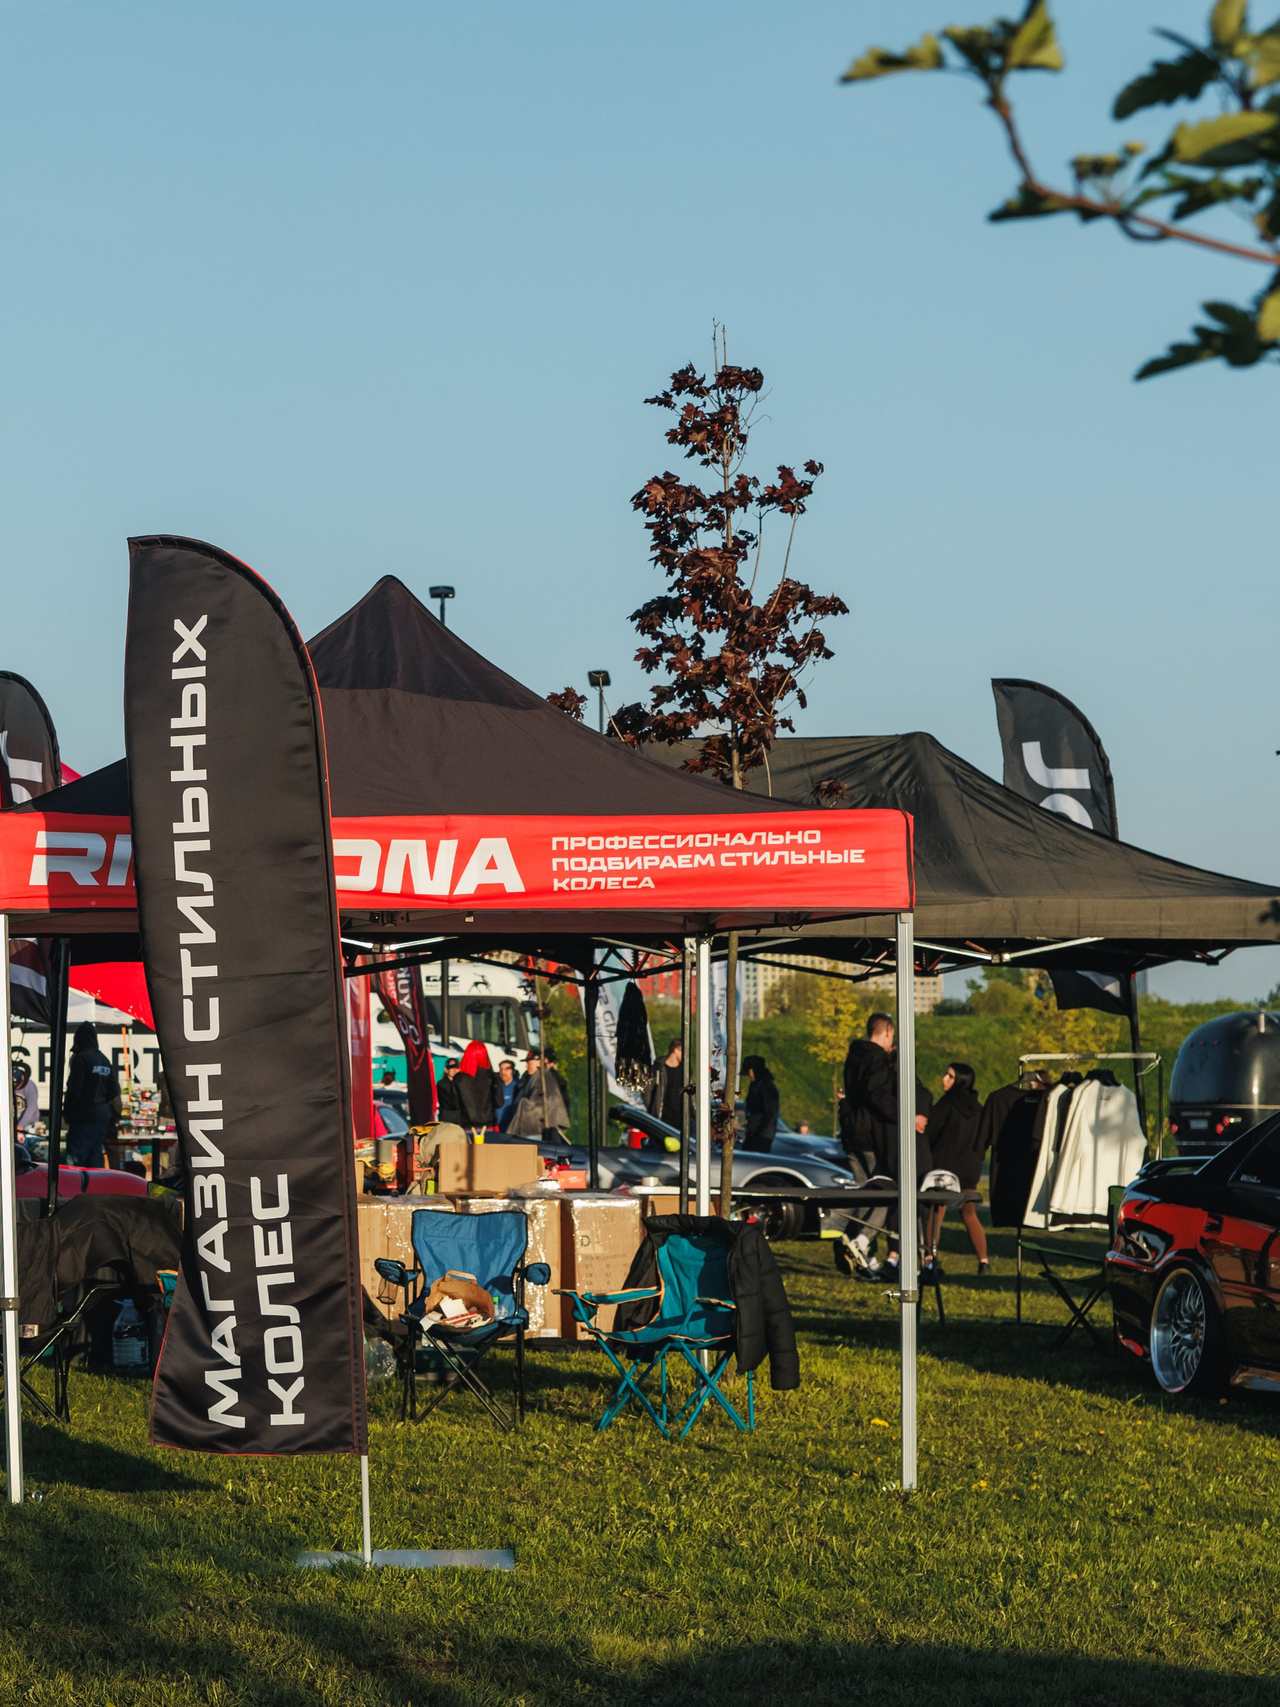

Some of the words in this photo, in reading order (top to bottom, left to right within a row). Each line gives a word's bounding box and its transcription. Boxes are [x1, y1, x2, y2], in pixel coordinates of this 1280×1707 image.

[170, 614, 220, 1042] СТИЛЬНЫХ
[552, 829, 821, 851] ПРОФЕССИОНАЛЬНО
[29, 831, 526, 895] RIONA
[552, 853, 715, 873] ПОДБИРАЕМ
[720, 848, 865, 869] СТИЛЬНЫЕ
[553, 876, 656, 892] КОЛЕСА
[10, 1046, 161, 1083] SPRT
[185, 1063, 245, 1428] МАГАЗИН
[251, 1174, 306, 1426] КОЛЕС
